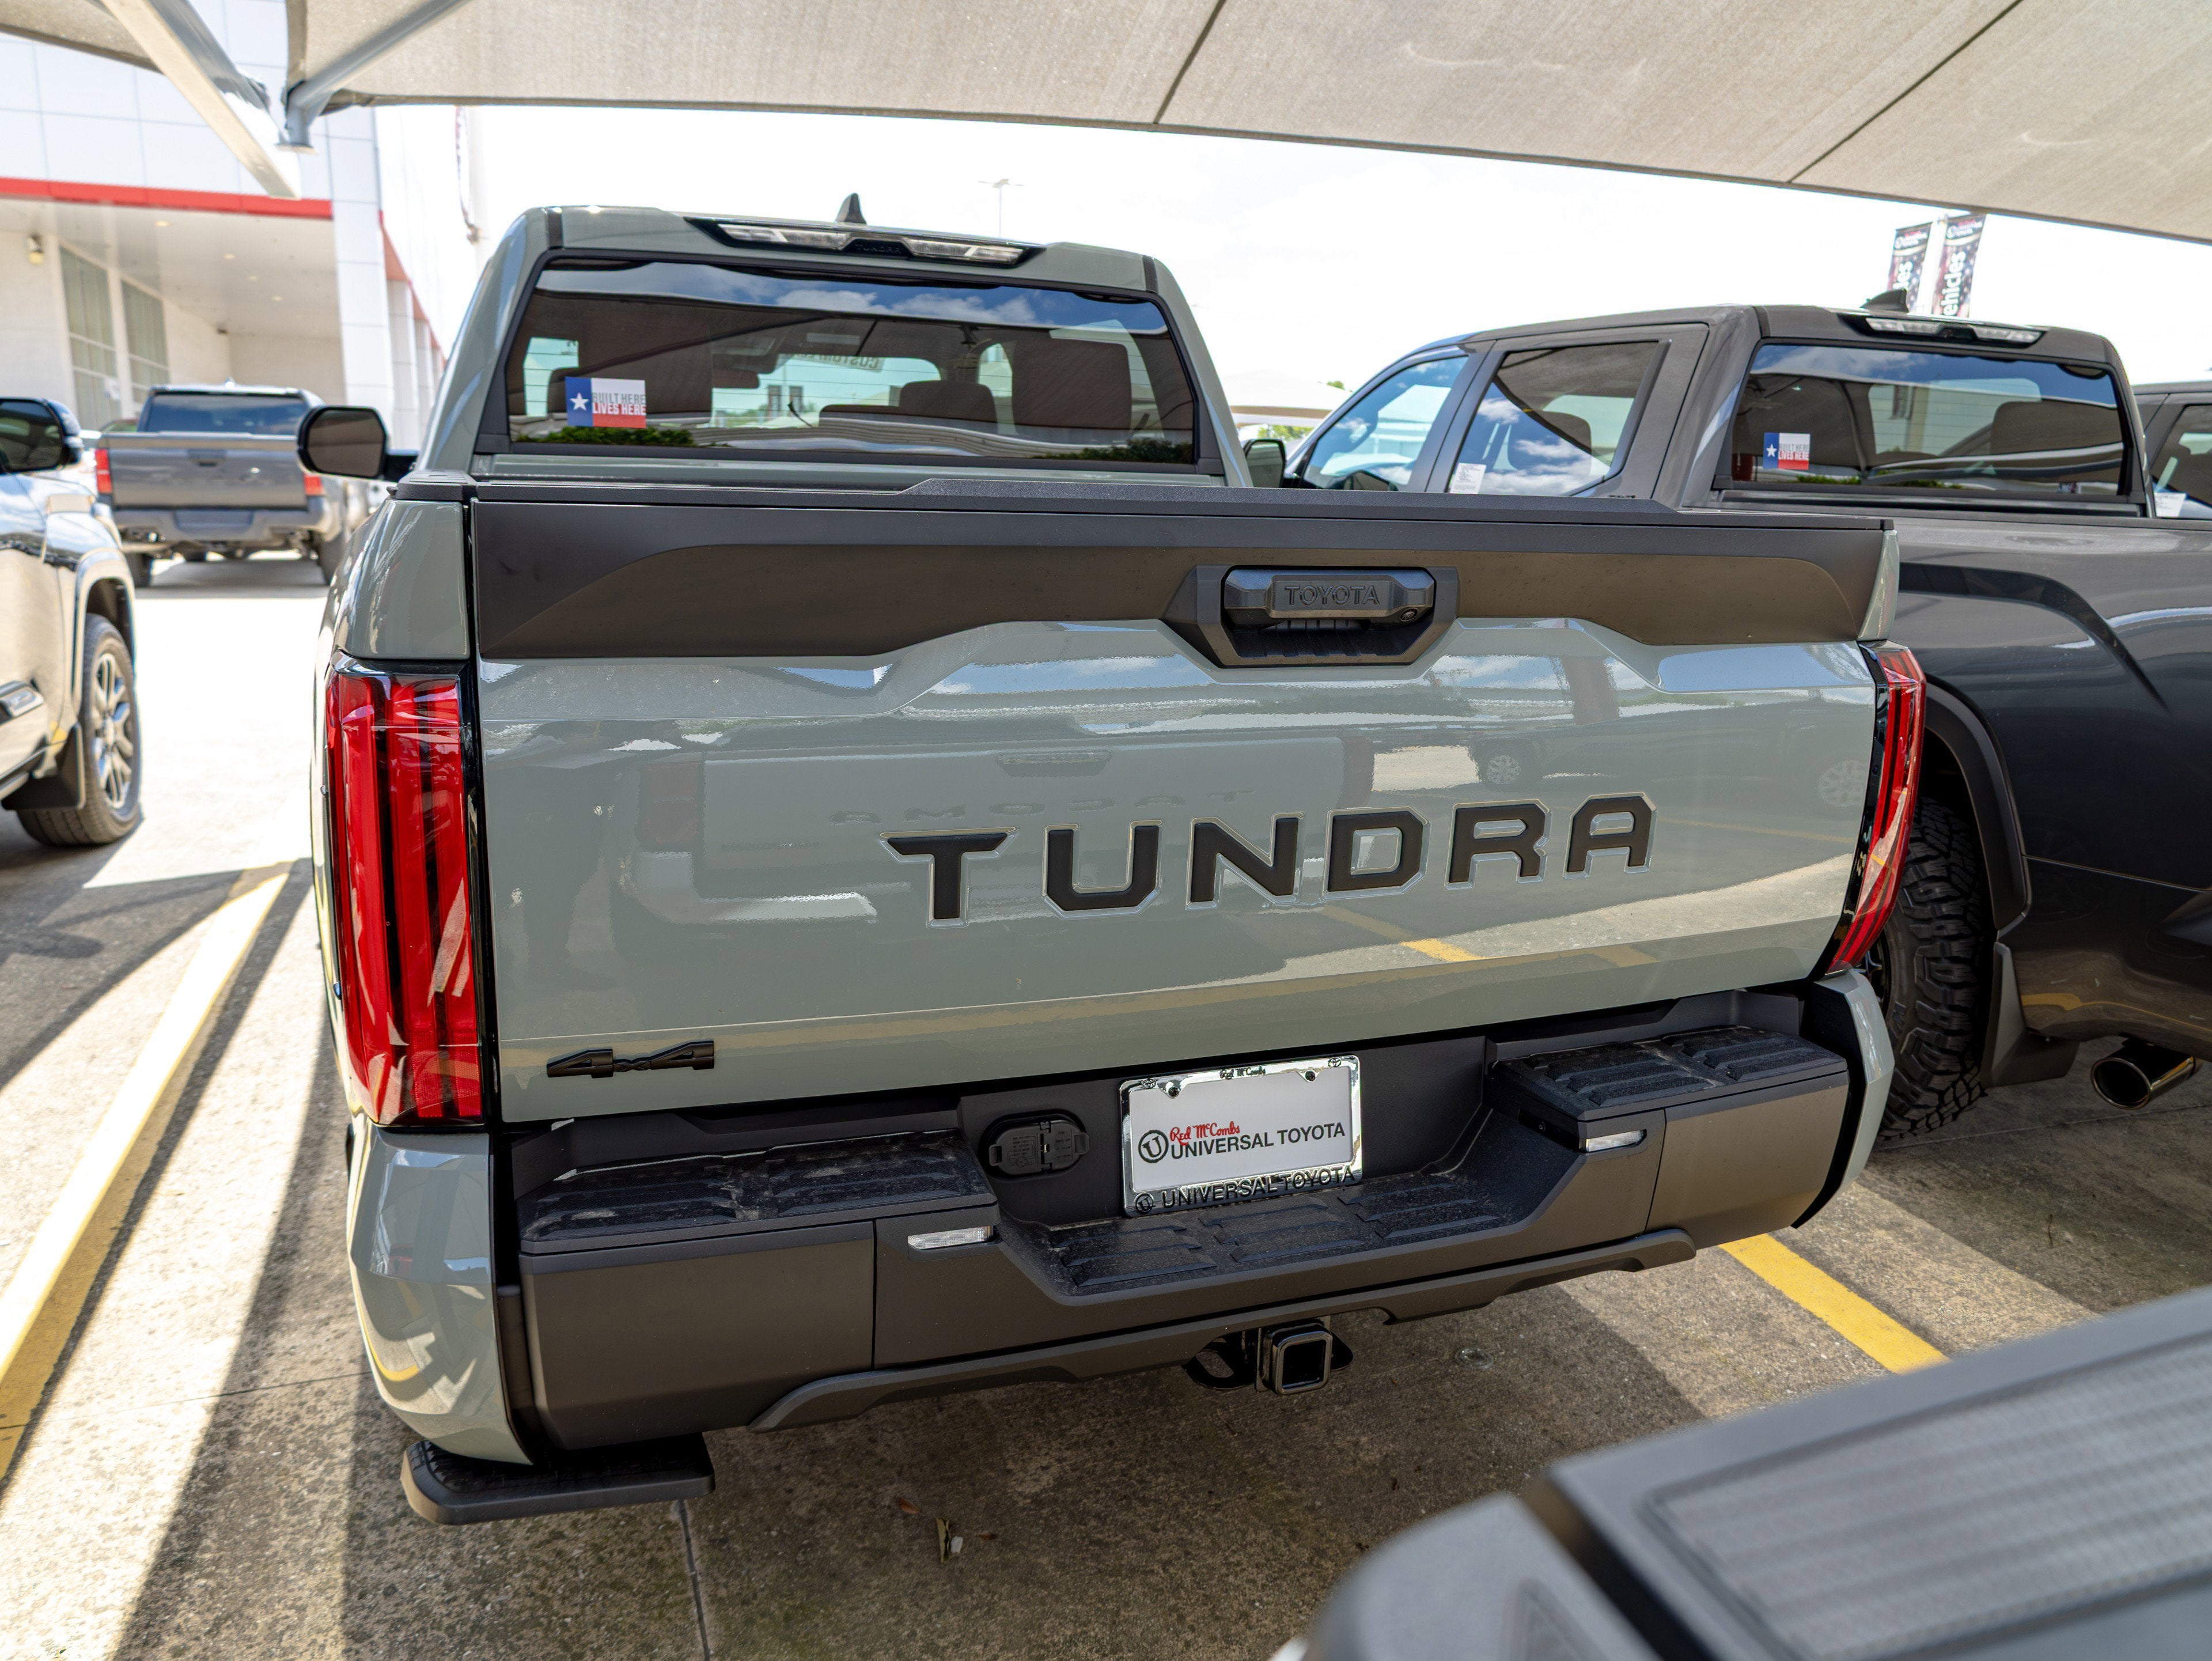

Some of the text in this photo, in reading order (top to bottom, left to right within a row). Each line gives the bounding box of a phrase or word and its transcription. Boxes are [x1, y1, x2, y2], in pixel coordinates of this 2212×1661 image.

[1941, 251, 1966, 316] ehicles
[593, 392, 645, 404] BUILT HERE
[593, 402, 646, 415] LIVES HERE
[1285, 585, 1380, 606] TOYOTA
[878, 792, 1657, 927] TUNDRA
[1219, 1068, 1234, 1080] Red
[1169, 1121, 1241, 1146] Red McCombs
[1171, 1122, 1346, 1159] UNIVERSAL TOYOTA
[1161, 1165, 1355, 1208] UNIVERSAL TOYOTA
